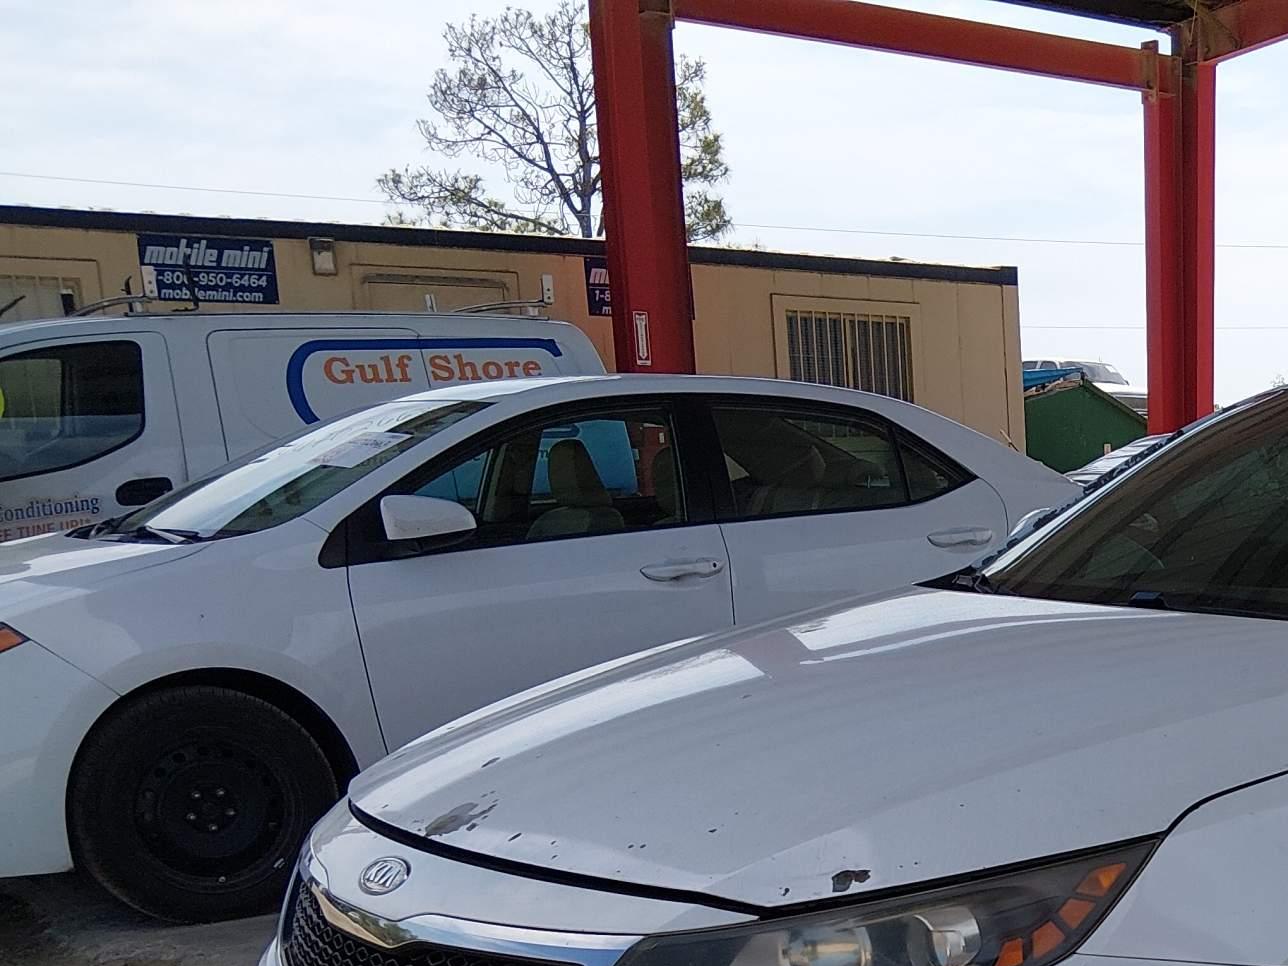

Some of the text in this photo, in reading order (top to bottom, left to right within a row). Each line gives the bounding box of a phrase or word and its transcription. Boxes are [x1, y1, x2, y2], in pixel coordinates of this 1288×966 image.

[221, 245, 269, 269] mini
[160, 287, 264, 302] moblemini.com
[323, 354, 542, 385] Gulf Shore
